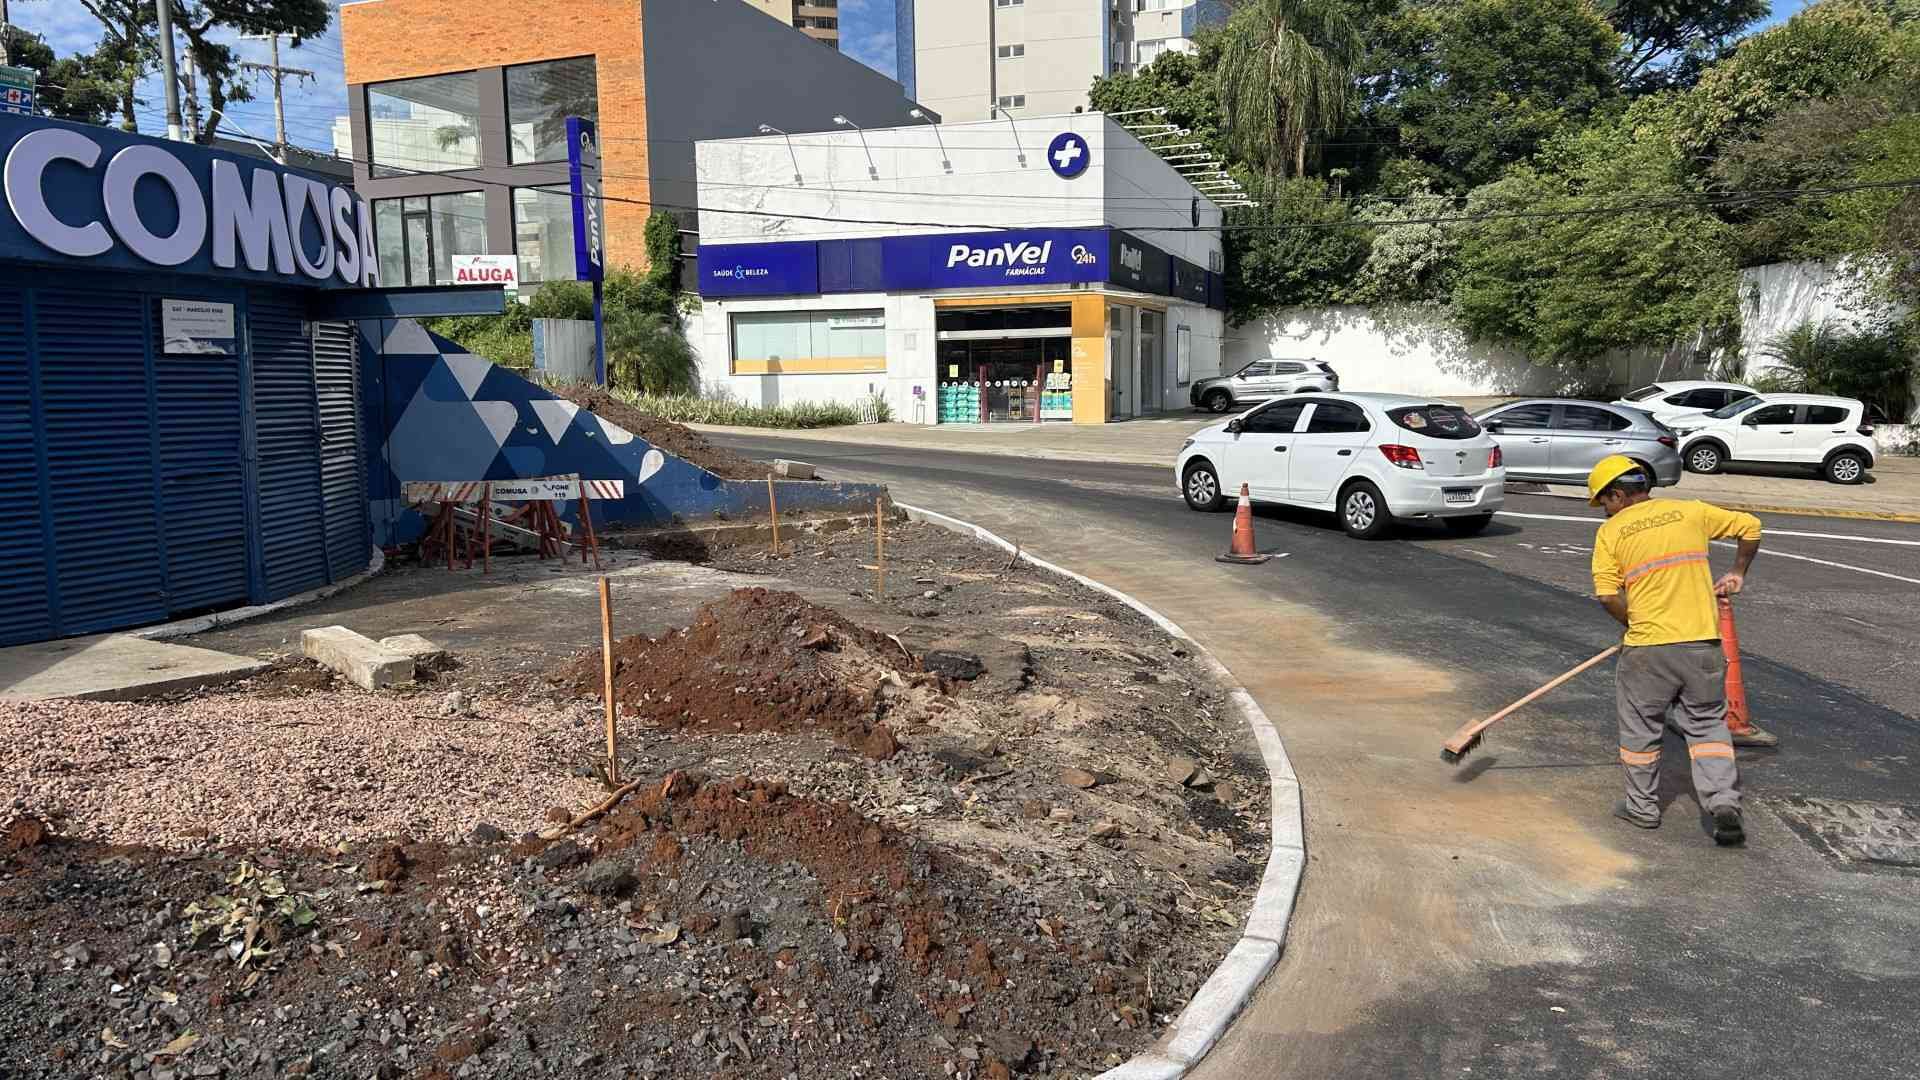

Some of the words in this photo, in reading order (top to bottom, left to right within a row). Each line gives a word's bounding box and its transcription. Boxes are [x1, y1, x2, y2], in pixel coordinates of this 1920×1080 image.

[4, 128, 382, 288] COMUSA
[947, 240, 1052, 268] PanVel
[1076, 252, 1096, 264] 24h
[457, 268, 515, 281] ALUGA
[745, 268, 769, 276] BELEZA
[1005, 266, 1046, 276] FARMÁCIAS
